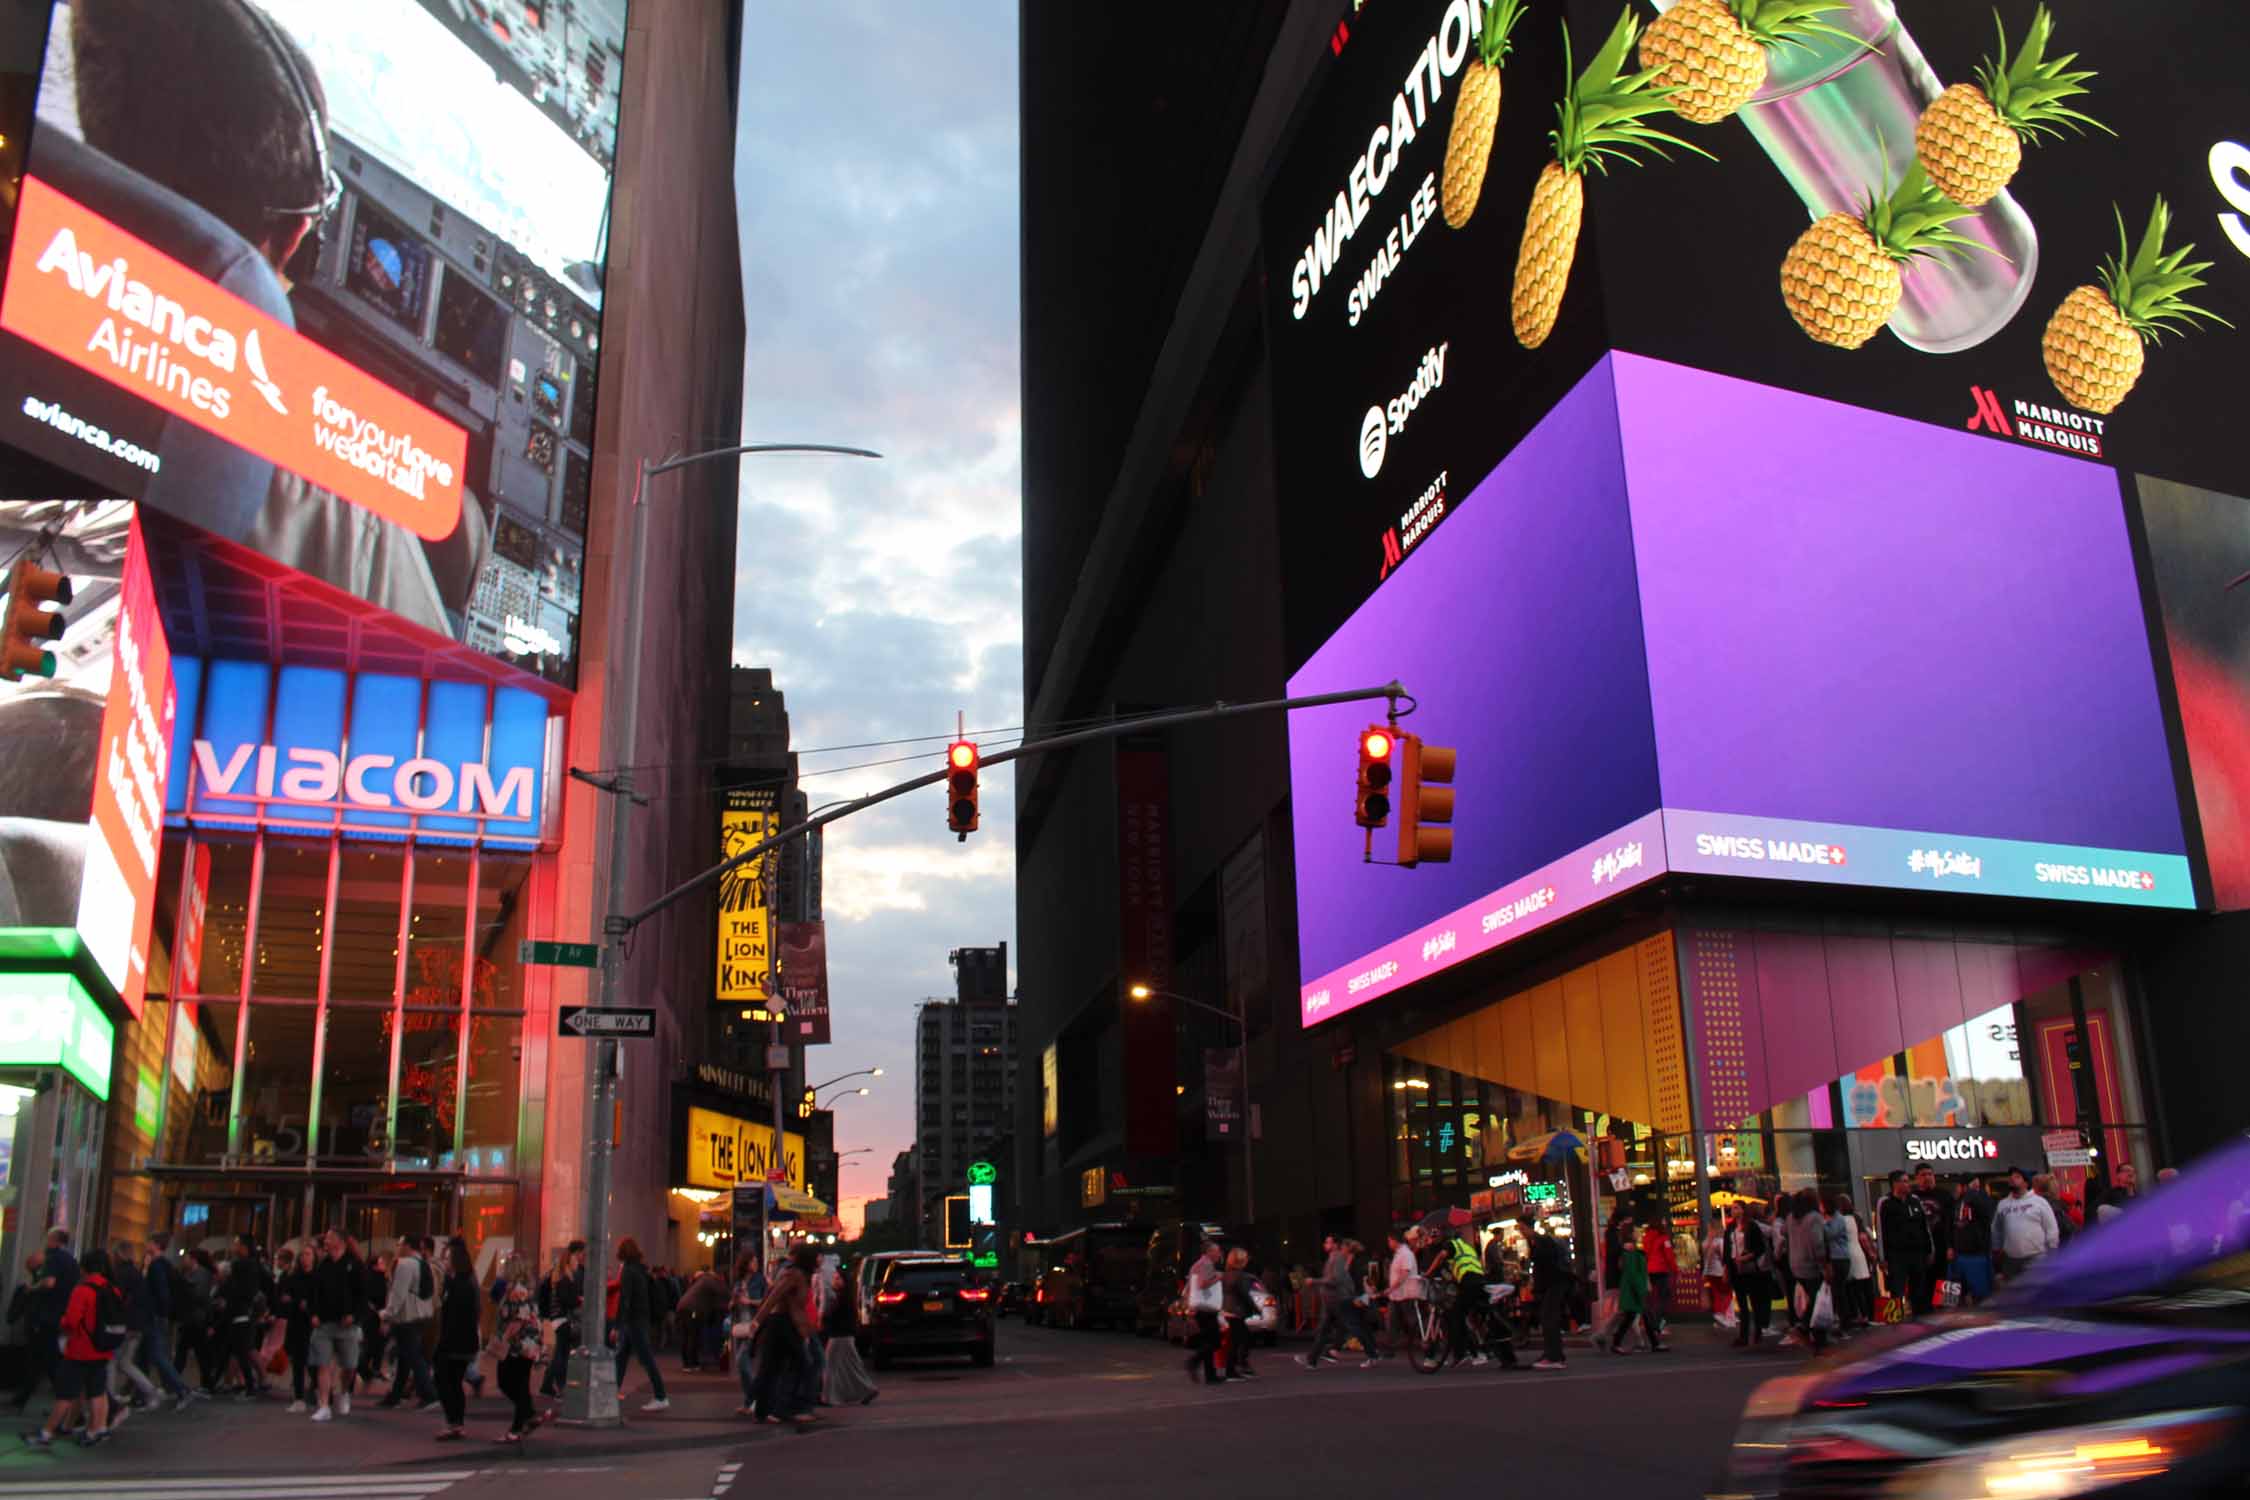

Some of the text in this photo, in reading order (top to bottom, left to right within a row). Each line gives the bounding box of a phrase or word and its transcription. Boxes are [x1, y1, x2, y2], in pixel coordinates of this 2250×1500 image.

[1348, 172, 1438, 326] SWAE LEE
[37, 228, 237, 372] Avianca
[87, 318, 231, 419] Airlines
[1387, 343, 1448, 435] Spotify
[23, 396, 160, 474] avianca.com
[2014, 399, 2104, 435] MARRIOTT
[2018, 421, 2099, 454] MARQUIS
[1401, 471, 1447, 530] MARRIOTT
[1402, 498, 1444, 549] MARQUIS
[1695, 834, 1829, 866] SWISS MADE
[2034, 862, 2141, 889] SWISS MADE
[731, 921, 760, 935] THE
[1481, 891, 1546, 934] SWISS MADE
[552, 944, 563, 963] 7
[725, 938, 766, 961] LION
[574, 1015, 644, 1028] ONE WAY
[711, 1133, 734, 1171] THE
[1905, 1135, 1984, 1161] swatch
